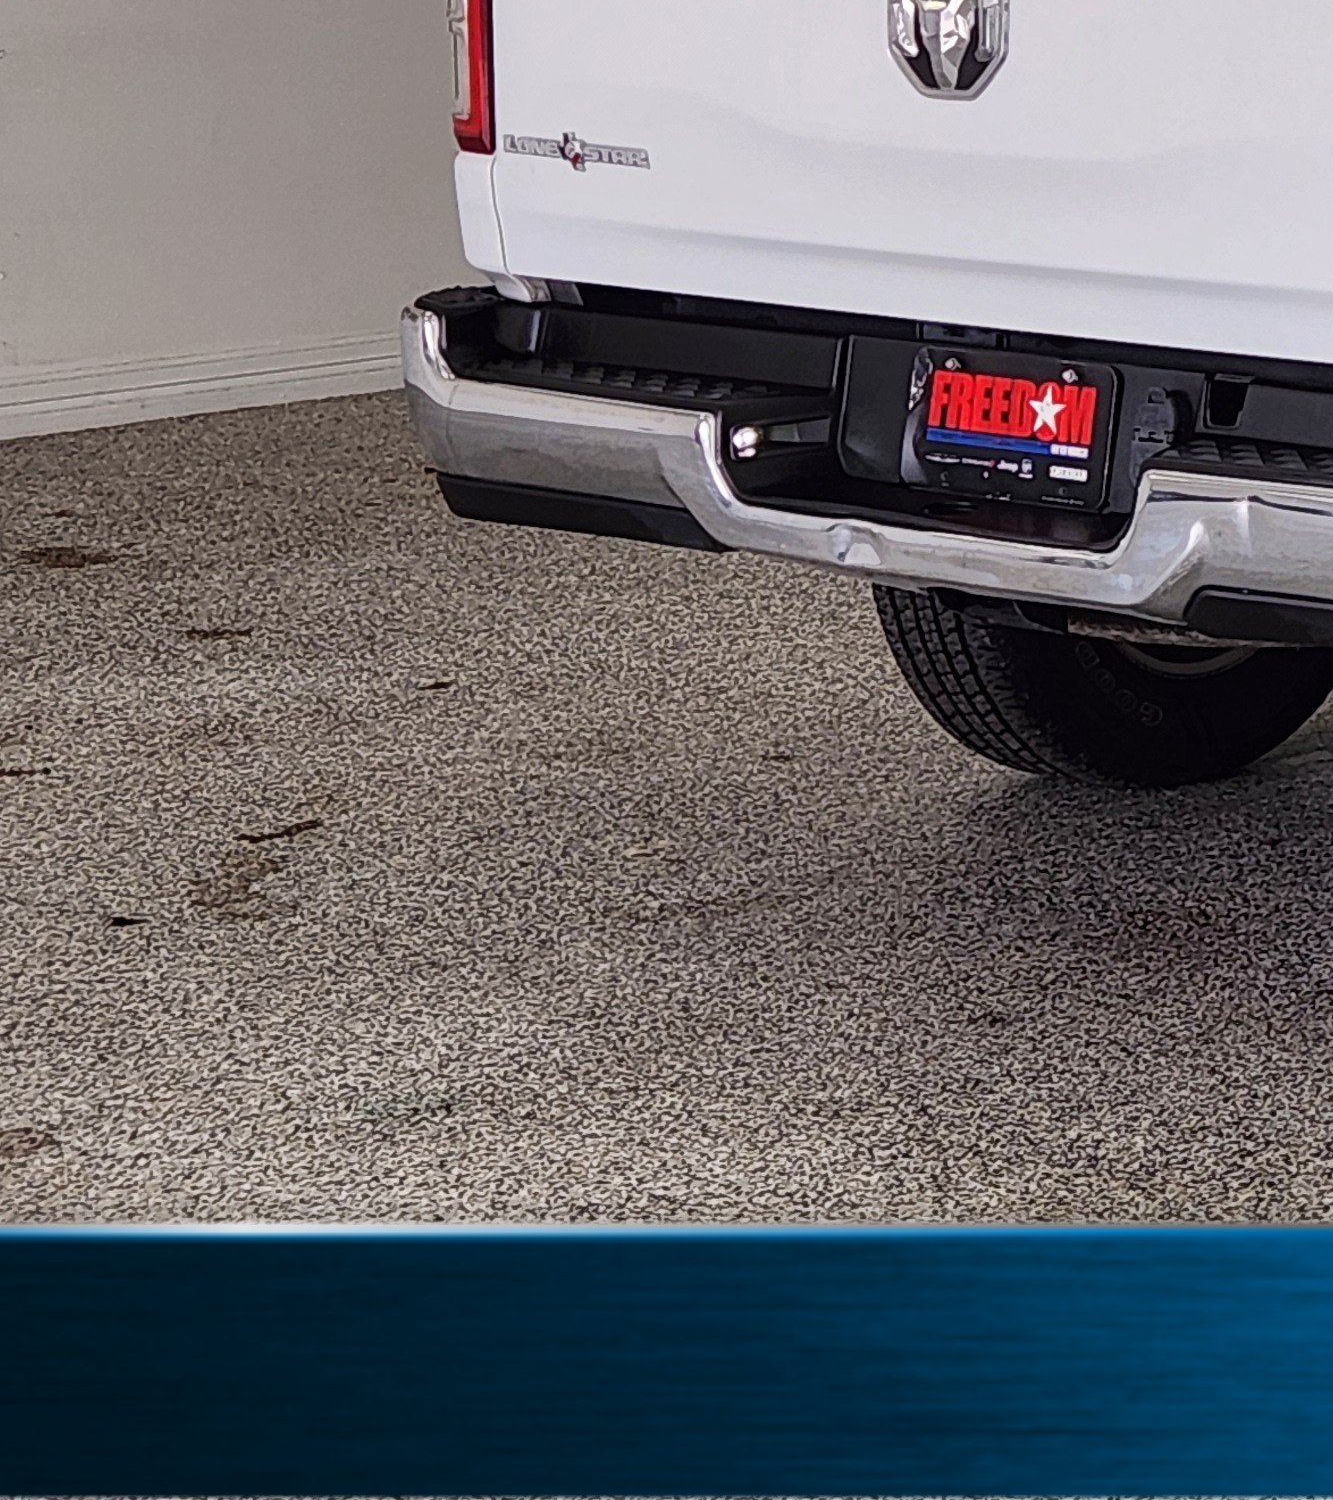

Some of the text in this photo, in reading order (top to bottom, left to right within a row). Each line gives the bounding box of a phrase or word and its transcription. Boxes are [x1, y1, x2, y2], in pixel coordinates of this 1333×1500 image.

[503, 134, 651, 169] LONE STAR
[927, 370, 1098, 446] FREEDOM
